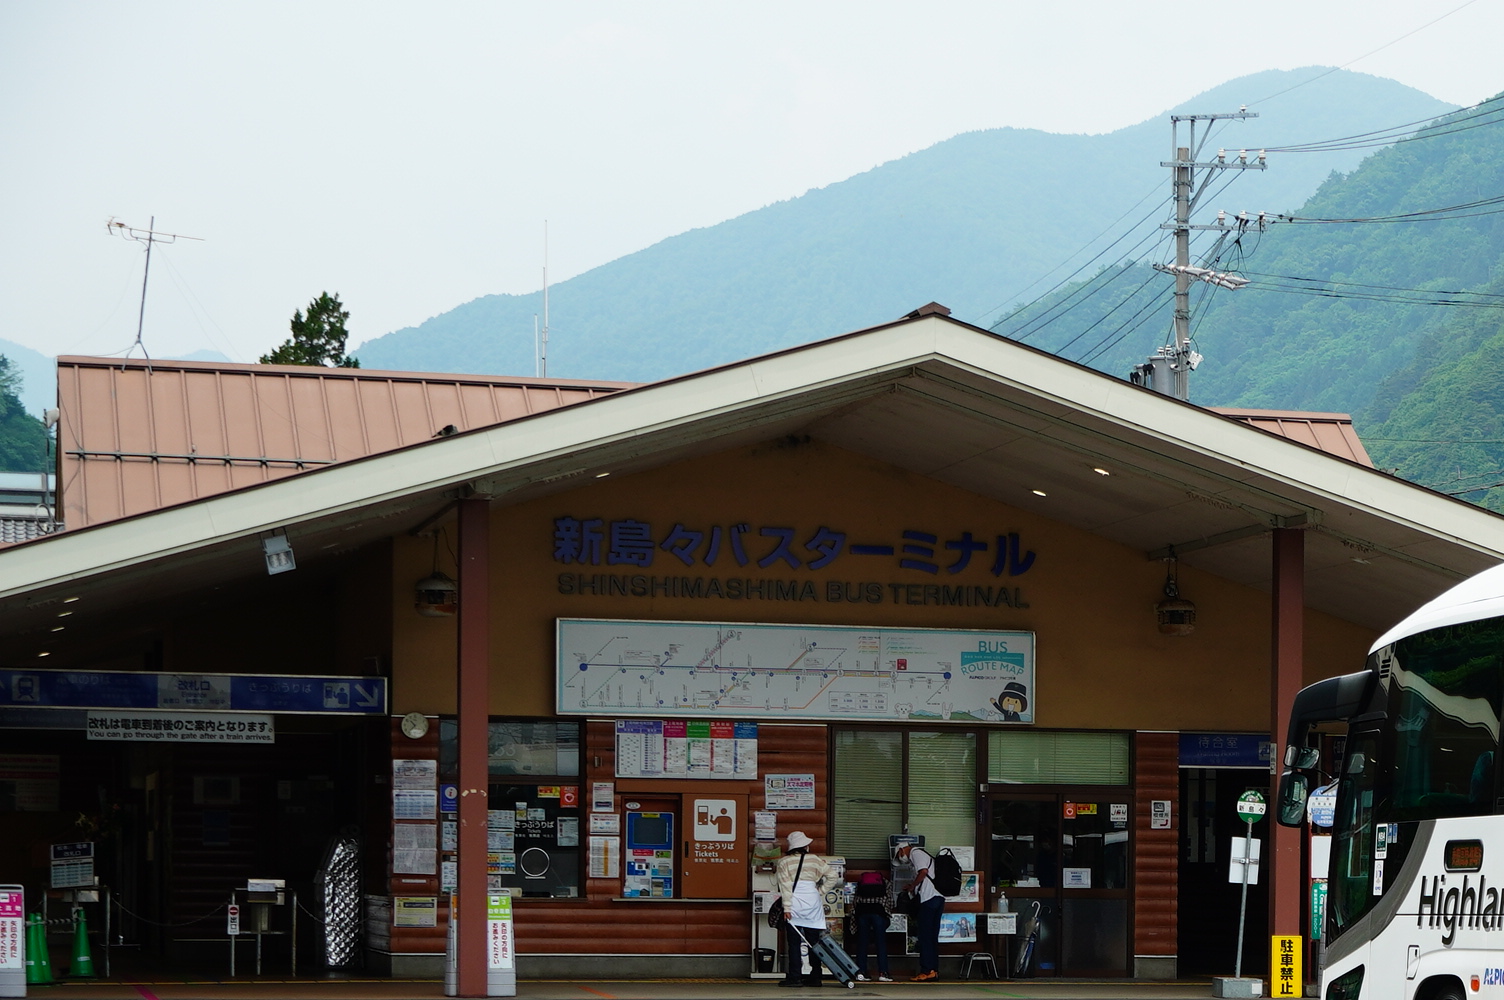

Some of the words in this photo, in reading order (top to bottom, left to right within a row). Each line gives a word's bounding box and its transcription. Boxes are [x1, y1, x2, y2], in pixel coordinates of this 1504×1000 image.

[553, 516, 1036, 578] 新島々バスターミナル
[557, 573, 820, 604] SHINSHIMASHIMA
[826, 583, 883, 605] BUS
[890, 583, 1030, 609] TERMINAL
[978, 640, 1008, 654] BUS
[961, 661, 997, 676] ROUTE
[999, 662, 1025, 677] MAP
[177, 680, 211, 692] 改札口
[88, 717, 274, 733] 改札は電車到着後のご案内となります。
[89, 729, 105, 738] You
[135, 731, 165, 740] through
[166, 731, 179, 739] the
[1198, 736, 1239, 749] 待合室
[694, 842, 735, 851] きっぷうりば
[694, 850, 719, 858] Tickets
[1279, 939, 1294, 995] 駐車禁止
